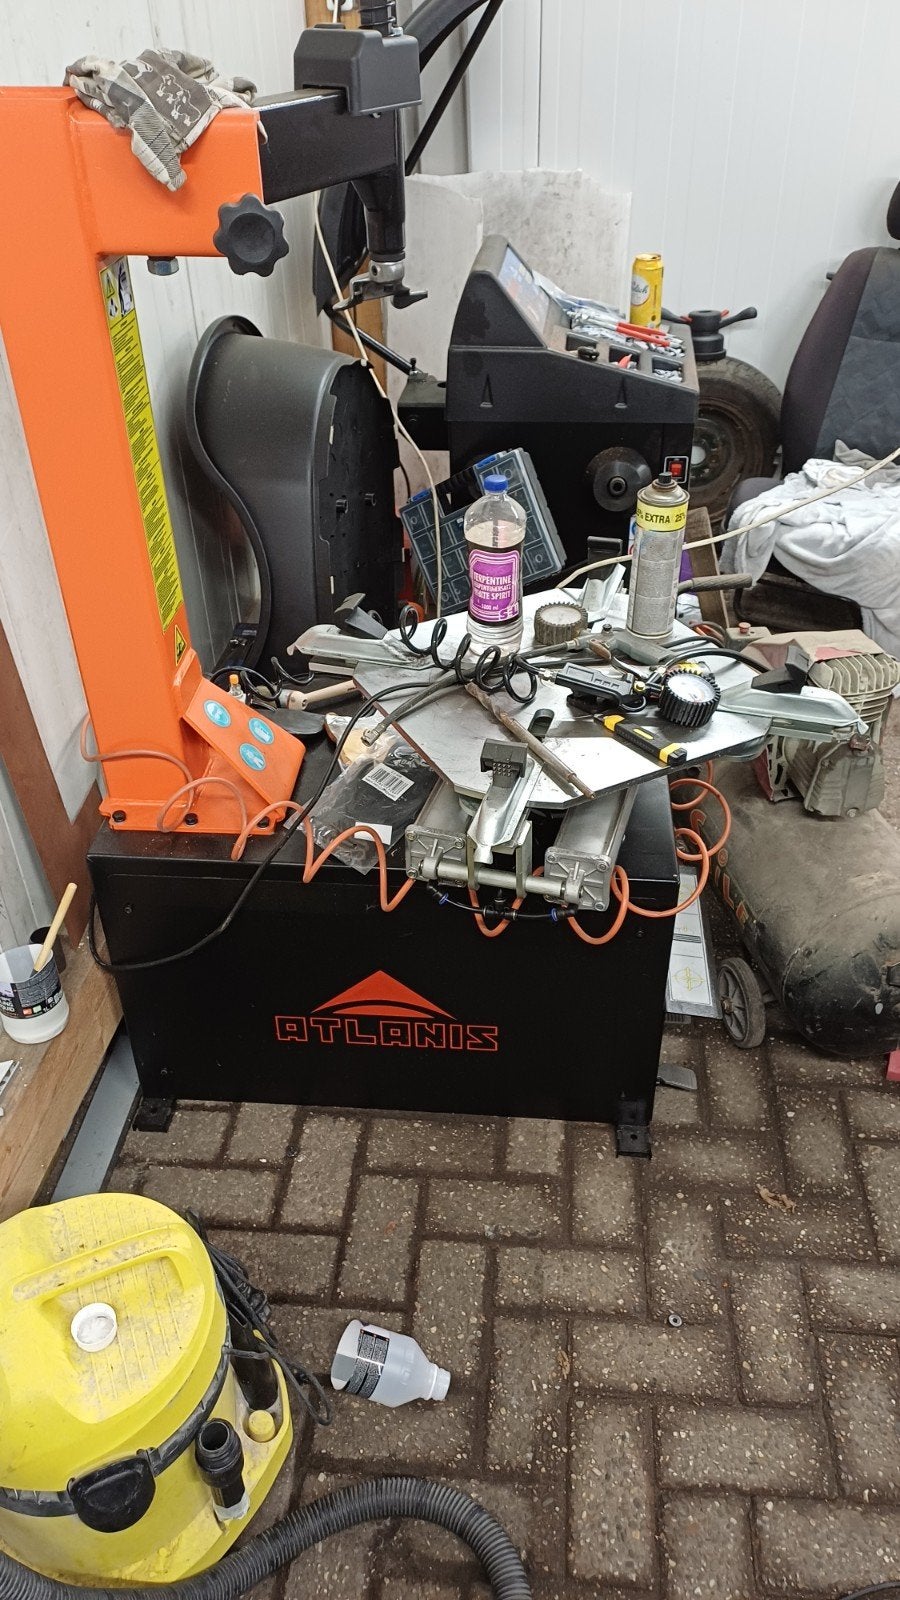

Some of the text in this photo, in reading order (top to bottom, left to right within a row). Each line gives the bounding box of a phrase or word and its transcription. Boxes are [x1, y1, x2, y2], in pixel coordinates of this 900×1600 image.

[645, 512, 670, 523] EXTRA
[473, 571, 512, 585] TERPENTINE
[491, 590, 511, 600] SPIRIT
[275, 1016, 498, 1051] ATLANIS
